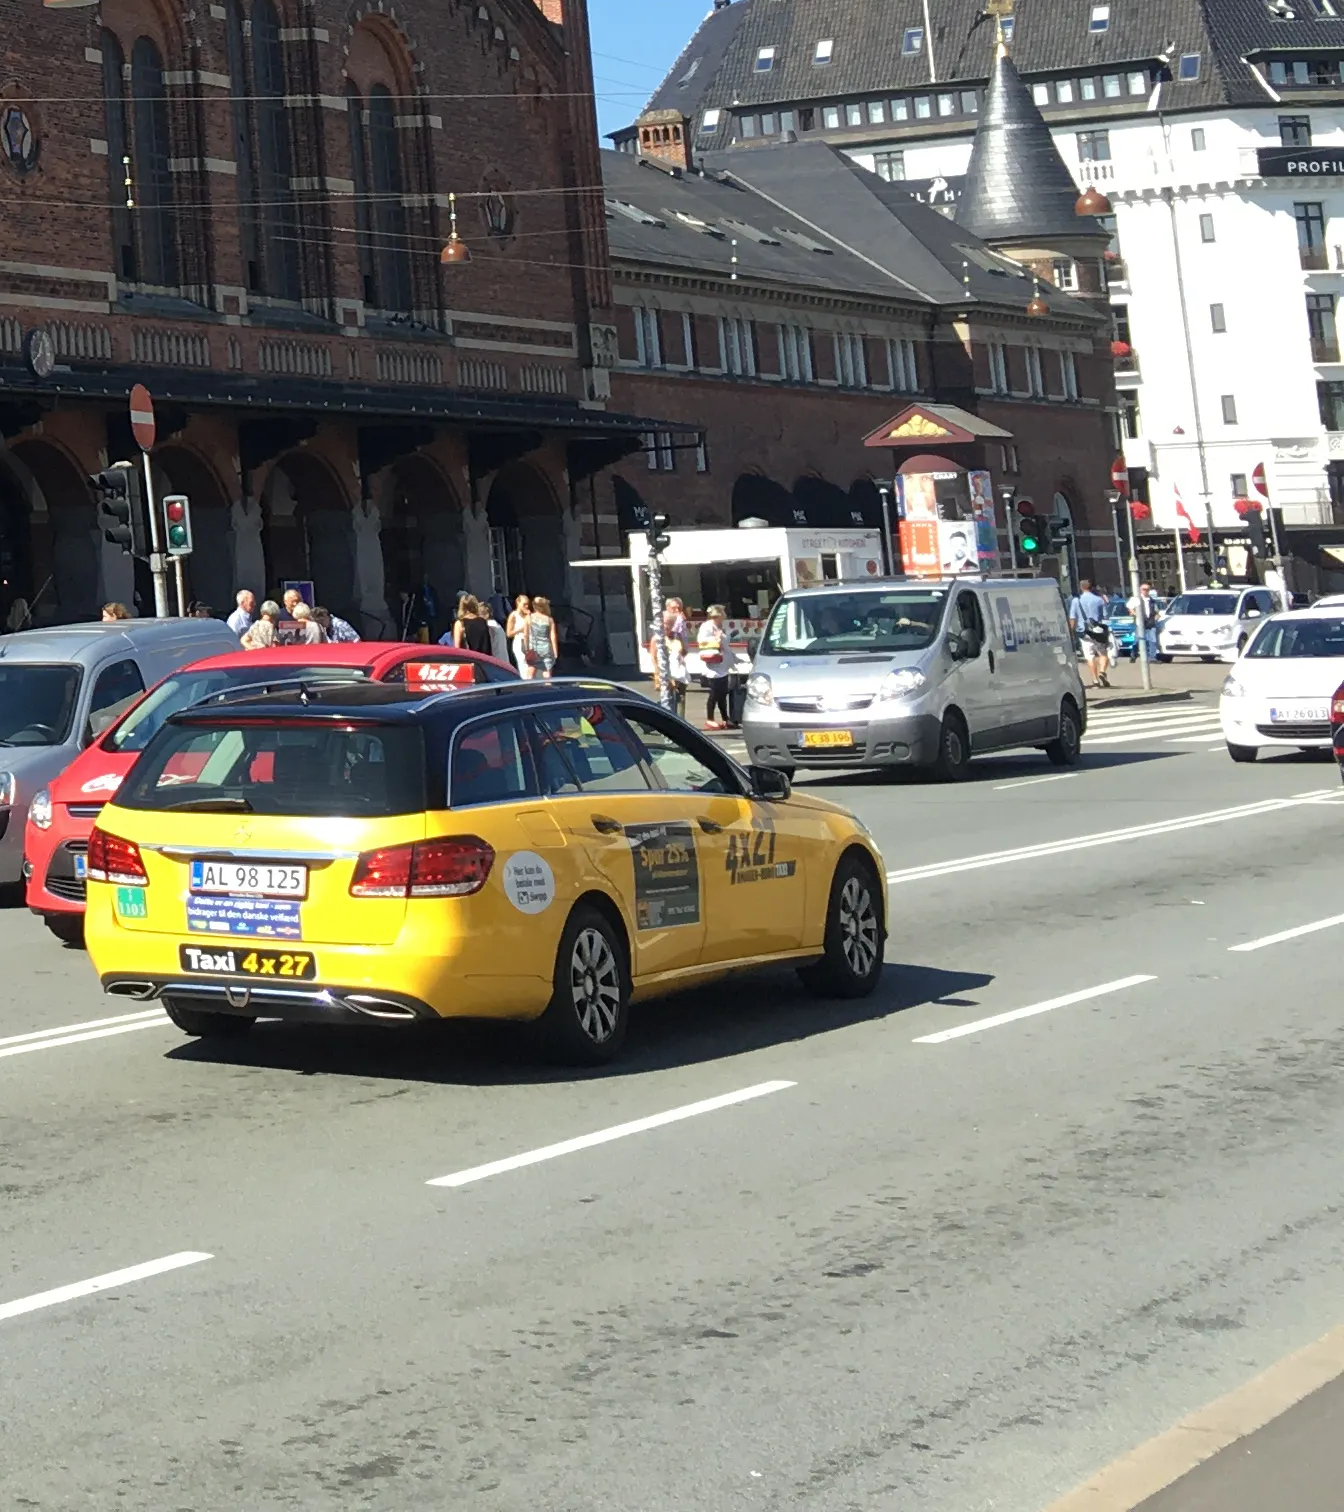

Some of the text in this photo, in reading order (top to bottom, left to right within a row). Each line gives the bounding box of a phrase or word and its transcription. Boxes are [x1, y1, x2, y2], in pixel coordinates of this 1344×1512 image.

[1287, 161, 1344, 173] PROFIL
[418, 663, 460, 681] 4x27
[805, 732, 817, 744] AC
[639, 842, 689, 872] Spar 25%
[204, 866, 301, 890] AL 98 125
[188, 907, 218, 918] bidrager
[218, 909, 226, 918] til
[226, 910, 242, 919] den
[242, 911, 269, 921] danske
[185, 948, 236, 972] Taxi
